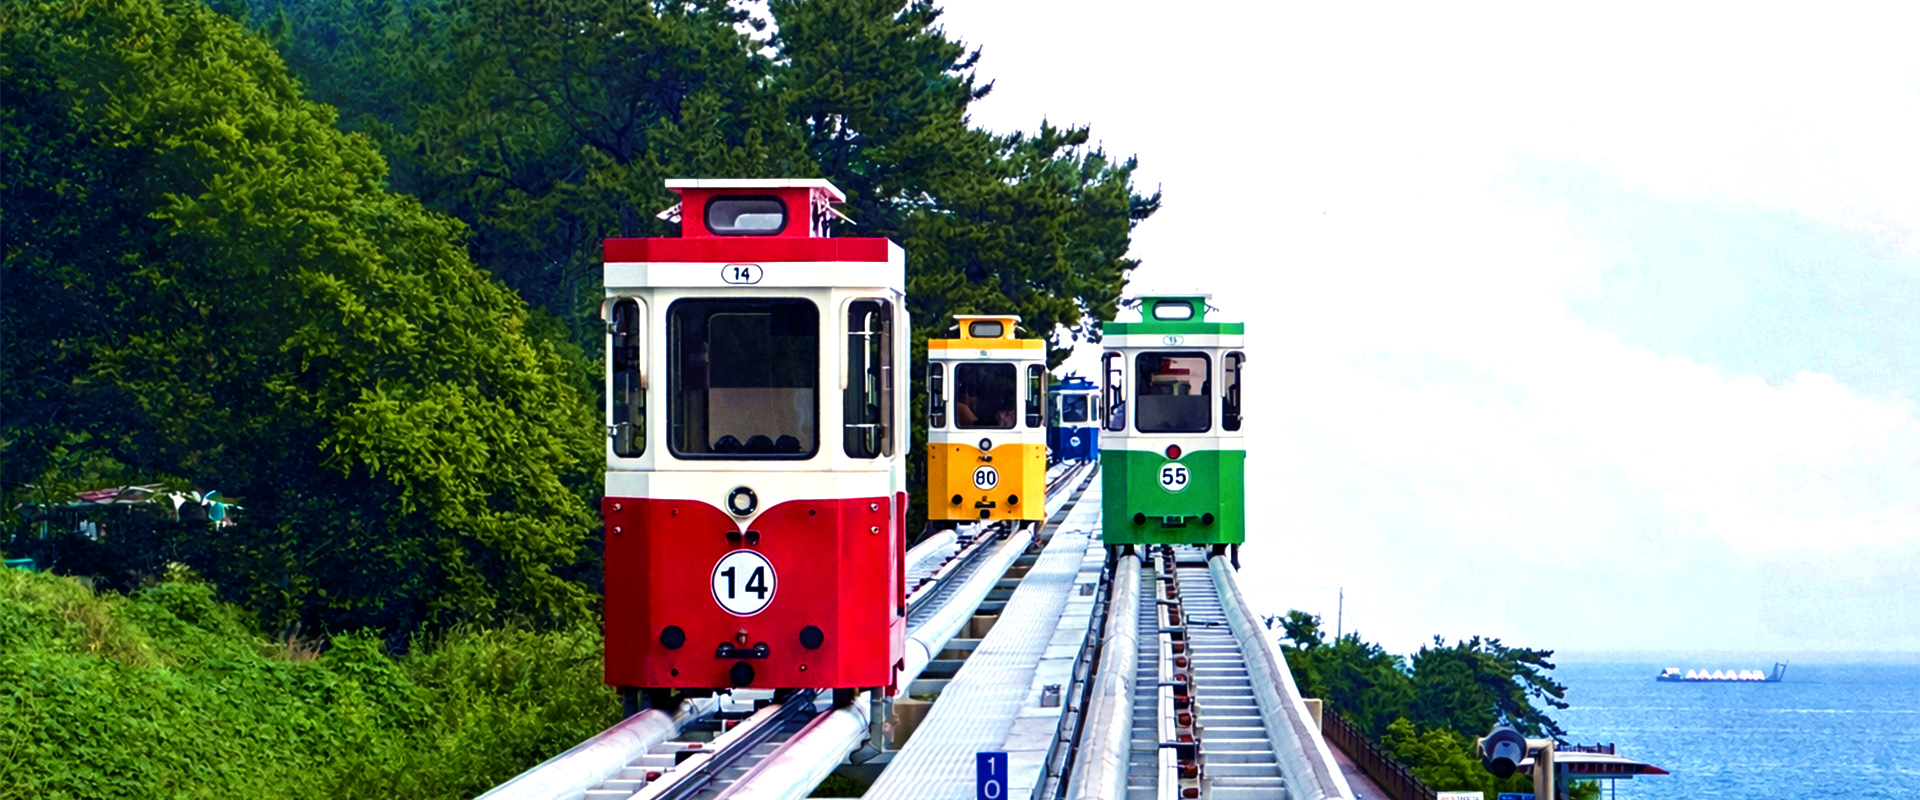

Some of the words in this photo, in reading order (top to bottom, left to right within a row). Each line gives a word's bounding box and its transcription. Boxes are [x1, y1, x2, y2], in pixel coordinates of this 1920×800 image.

[734, 267, 750, 283] 14
[975, 470, 996, 486] 80
[1162, 467, 1187, 486] 55
[721, 566, 768, 600] 14
